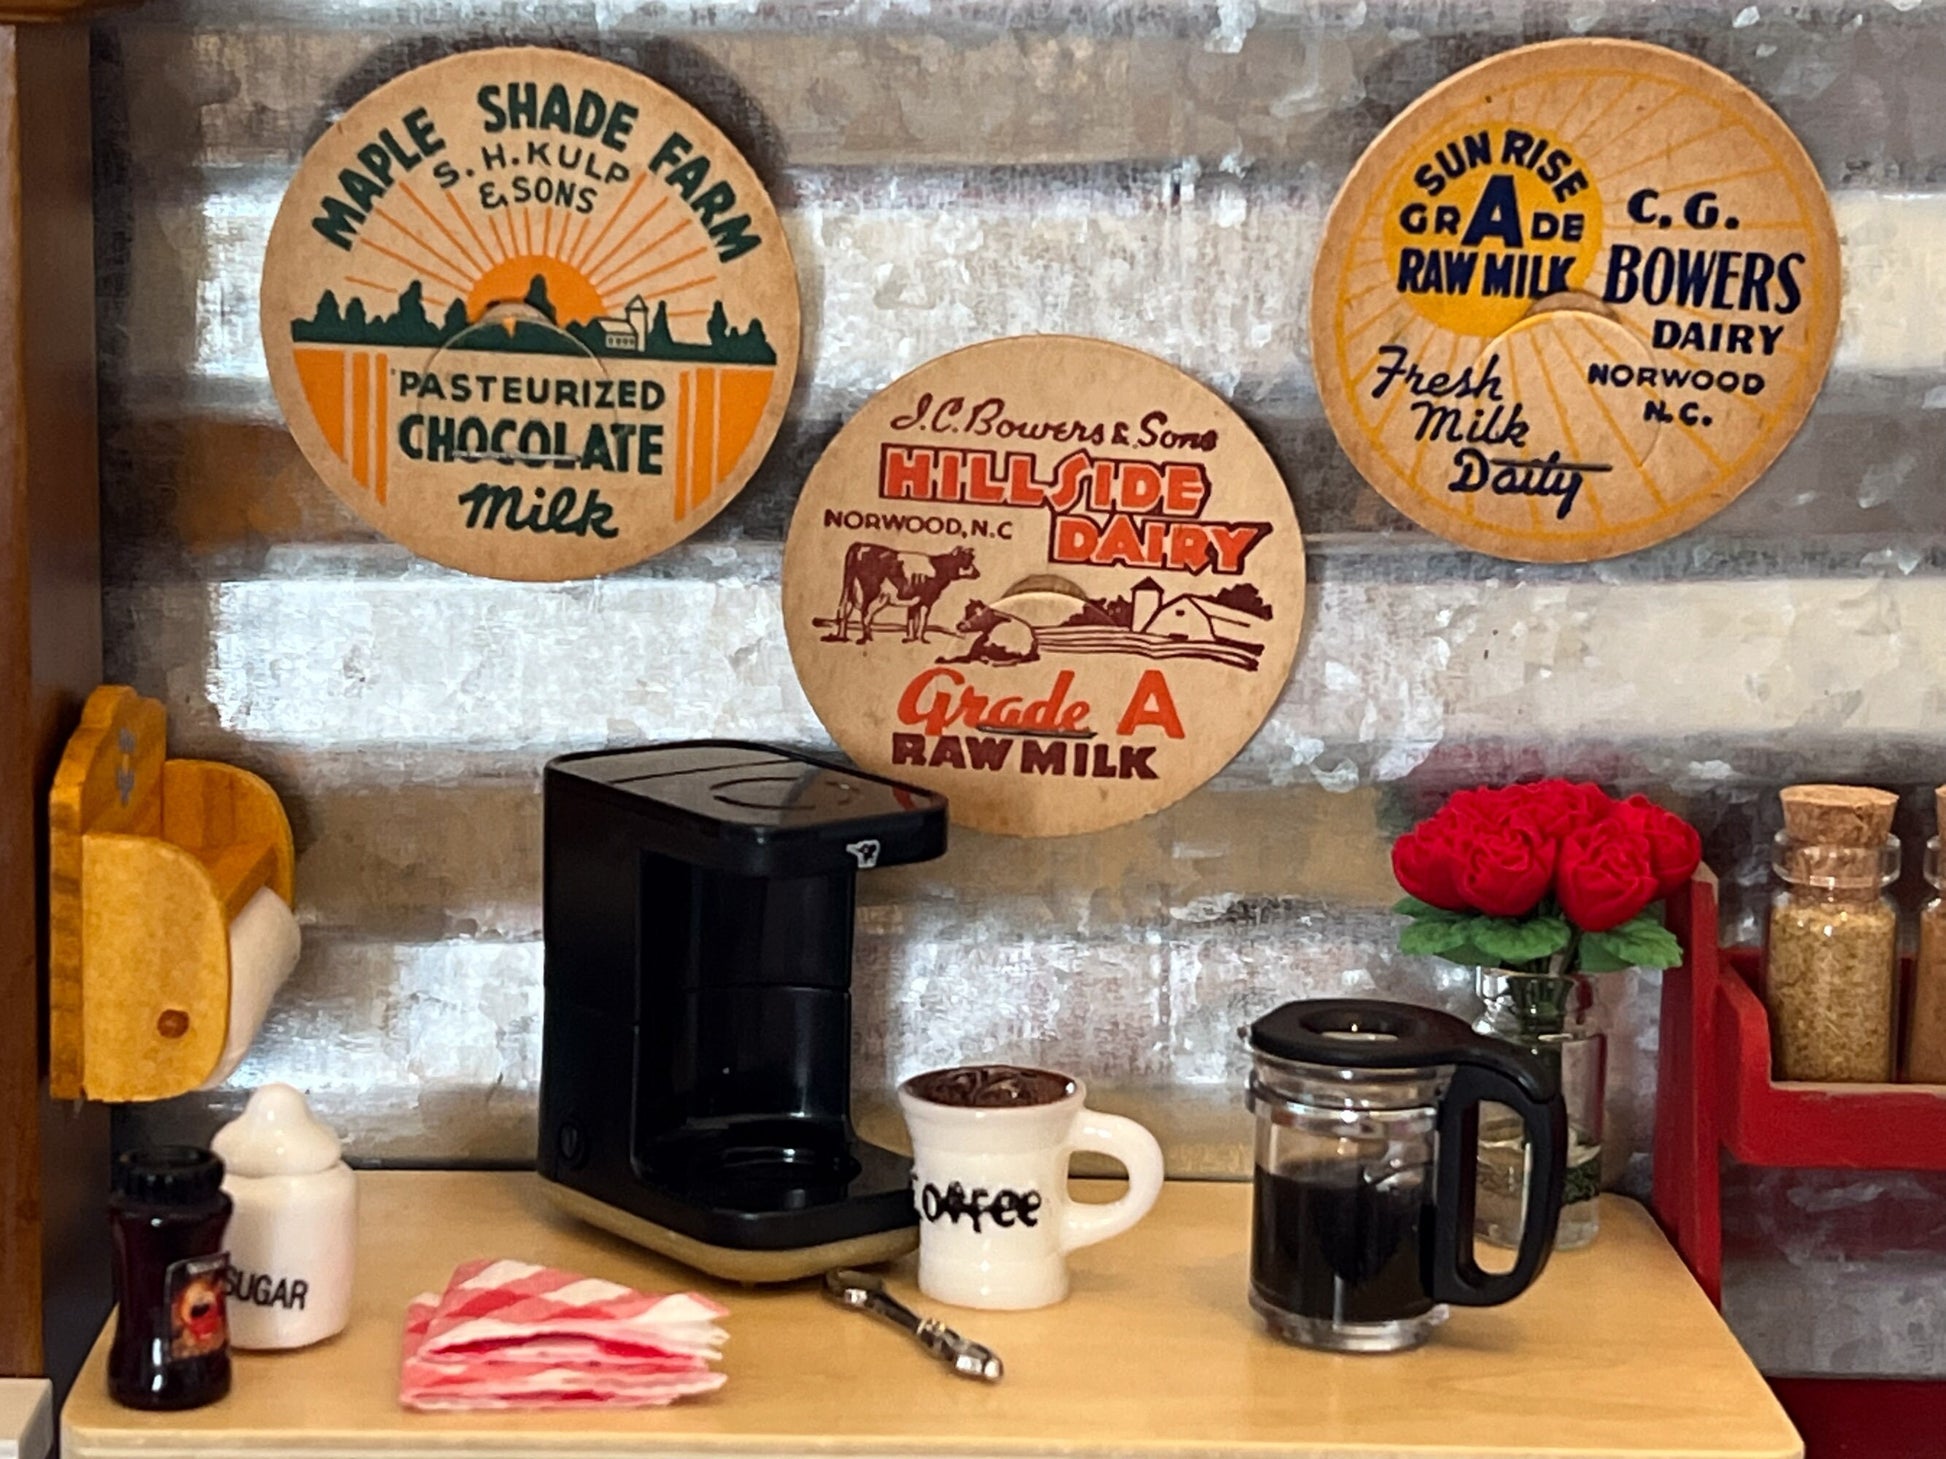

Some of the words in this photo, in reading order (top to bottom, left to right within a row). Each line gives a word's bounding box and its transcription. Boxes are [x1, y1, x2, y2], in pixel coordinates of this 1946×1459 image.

[312, 107, 446, 251] MAPLE
[476, 82, 639, 152] SHADE
[648, 132, 763, 263] FARM
[1414, 129, 1492, 197] SUN
[1502, 129, 1589, 204] RISE
[1397, 247, 1478, 295] RAW
[1481, 252, 1577, 299] MILK
[1602, 244, 1806, 315] BOWERS
[1652, 319, 1784, 356] DAIRY
[399, 370, 667, 411] PASTEURIZED
[1371, 345, 1503, 401] Fresh
[1588, 363, 1765, 395] NORWOOD
[397, 413, 664, 475] CHOCOLATE
[1410, 400, 1530, 448] Milk
[458, 483, 619, 539] Milk
[881, 443, 1212, 518] HILLSIDE
[1447, 447, 1584, 519] Daily
[1049, 510, 1273, 576] DAIRY
[897, 667, 1091, 736] Grade
[1116, 669, 1186, 740] A
[892, 732, 1014, 771] RAW
[1020, 738, 1160, 780] MILK
[911, 1172, 1042, 1234] offee
